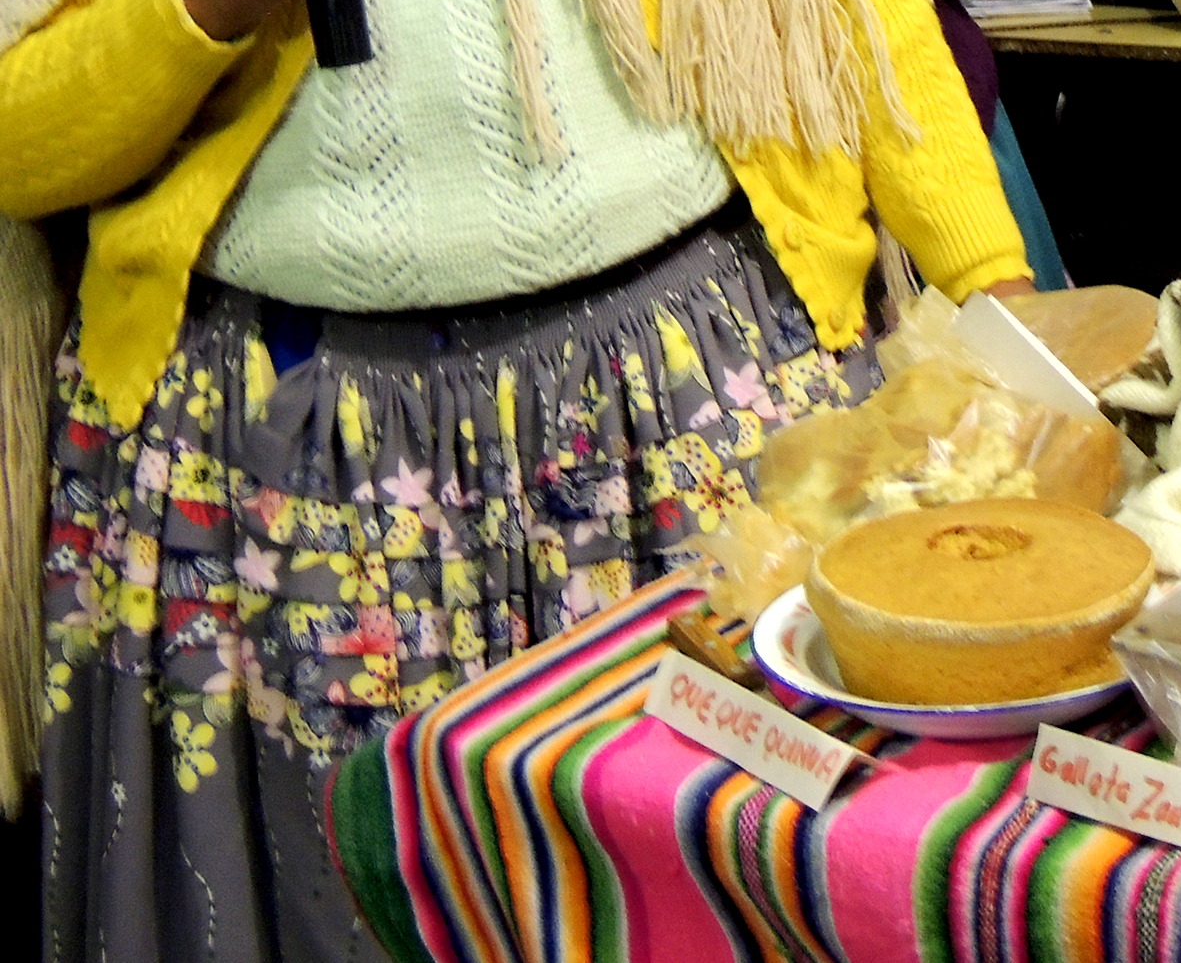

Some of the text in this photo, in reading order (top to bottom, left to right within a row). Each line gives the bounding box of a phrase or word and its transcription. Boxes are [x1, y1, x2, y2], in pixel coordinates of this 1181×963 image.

[670, 673, 716, 725] QUE
[715, 699, 763, 745] QUE
[1038, 745, 1132, 804] Galleta
